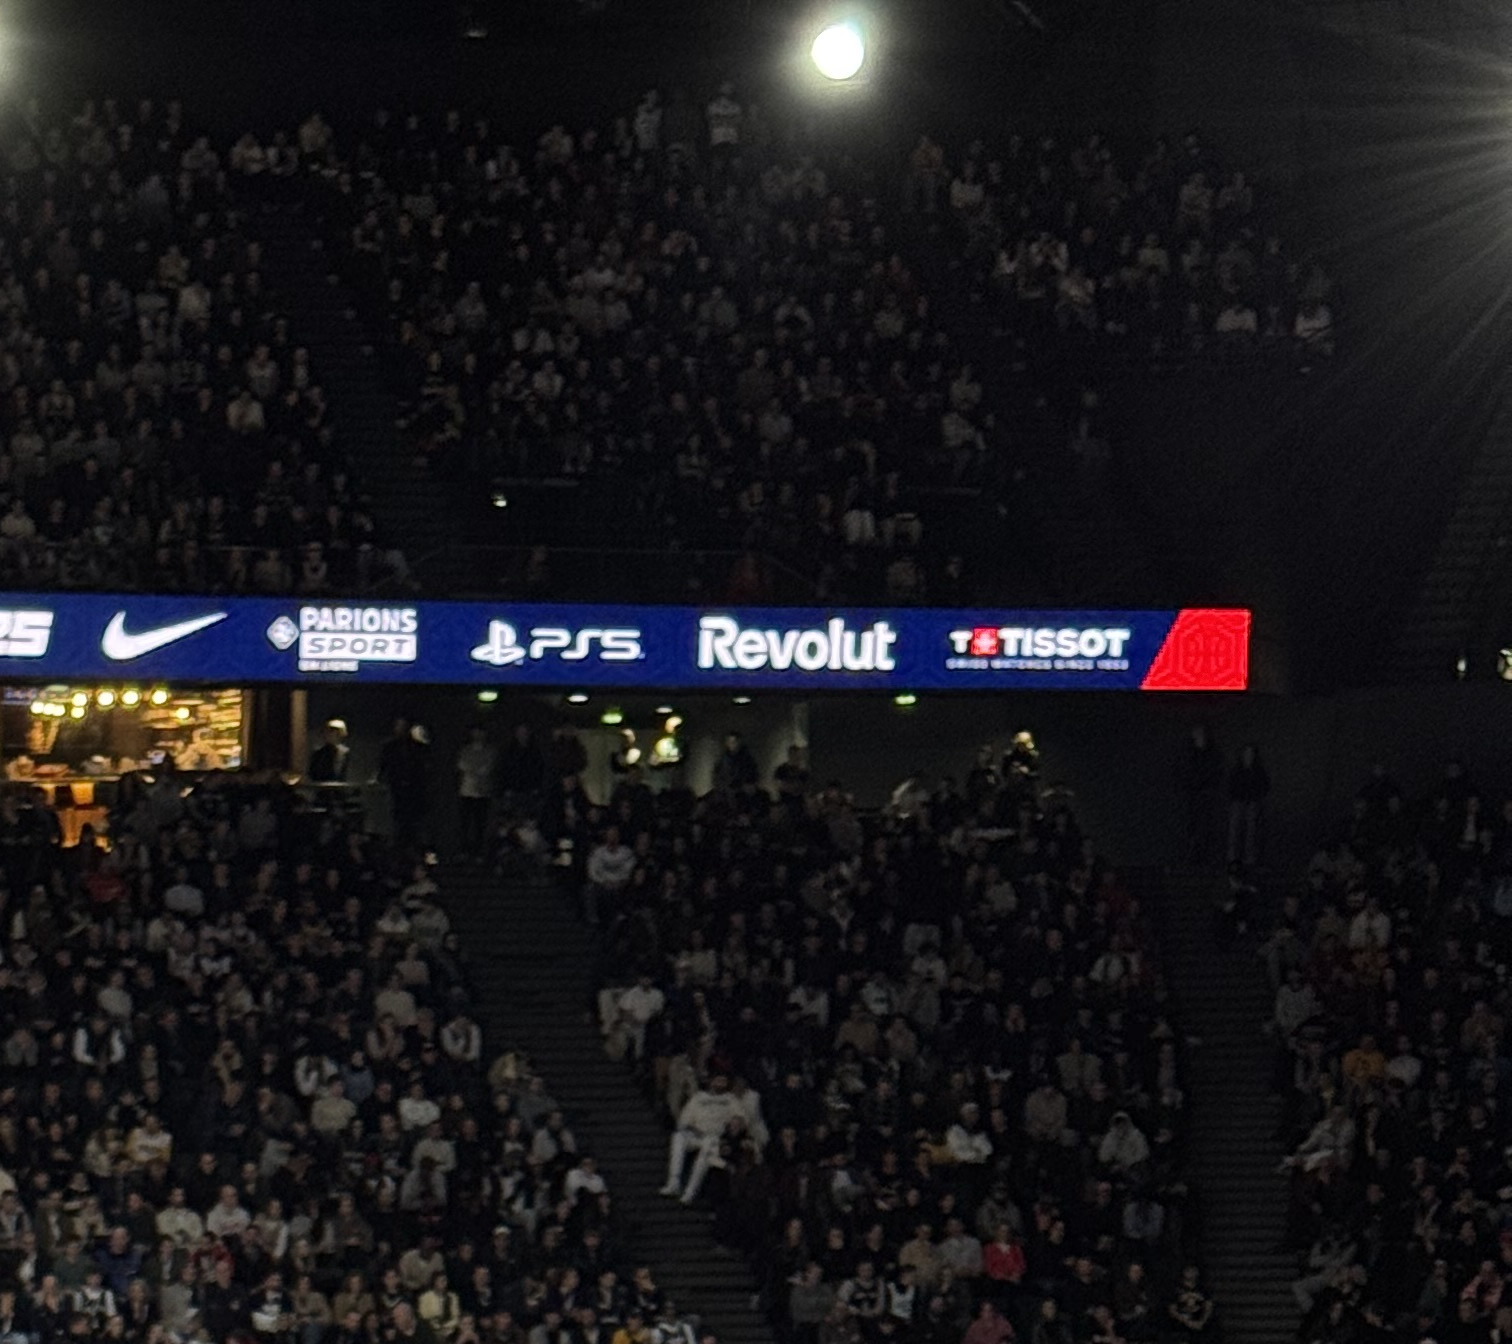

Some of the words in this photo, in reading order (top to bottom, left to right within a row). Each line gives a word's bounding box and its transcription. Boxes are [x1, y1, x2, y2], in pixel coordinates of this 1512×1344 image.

[299, 607, 418, 633] PARIONS
[307, 637, 410, 656] SPORT
[529, 627, 641, 660] PS5
[697, 615, 896, 670] Revolut
[998, 627, 1131, 658] TISSOT
